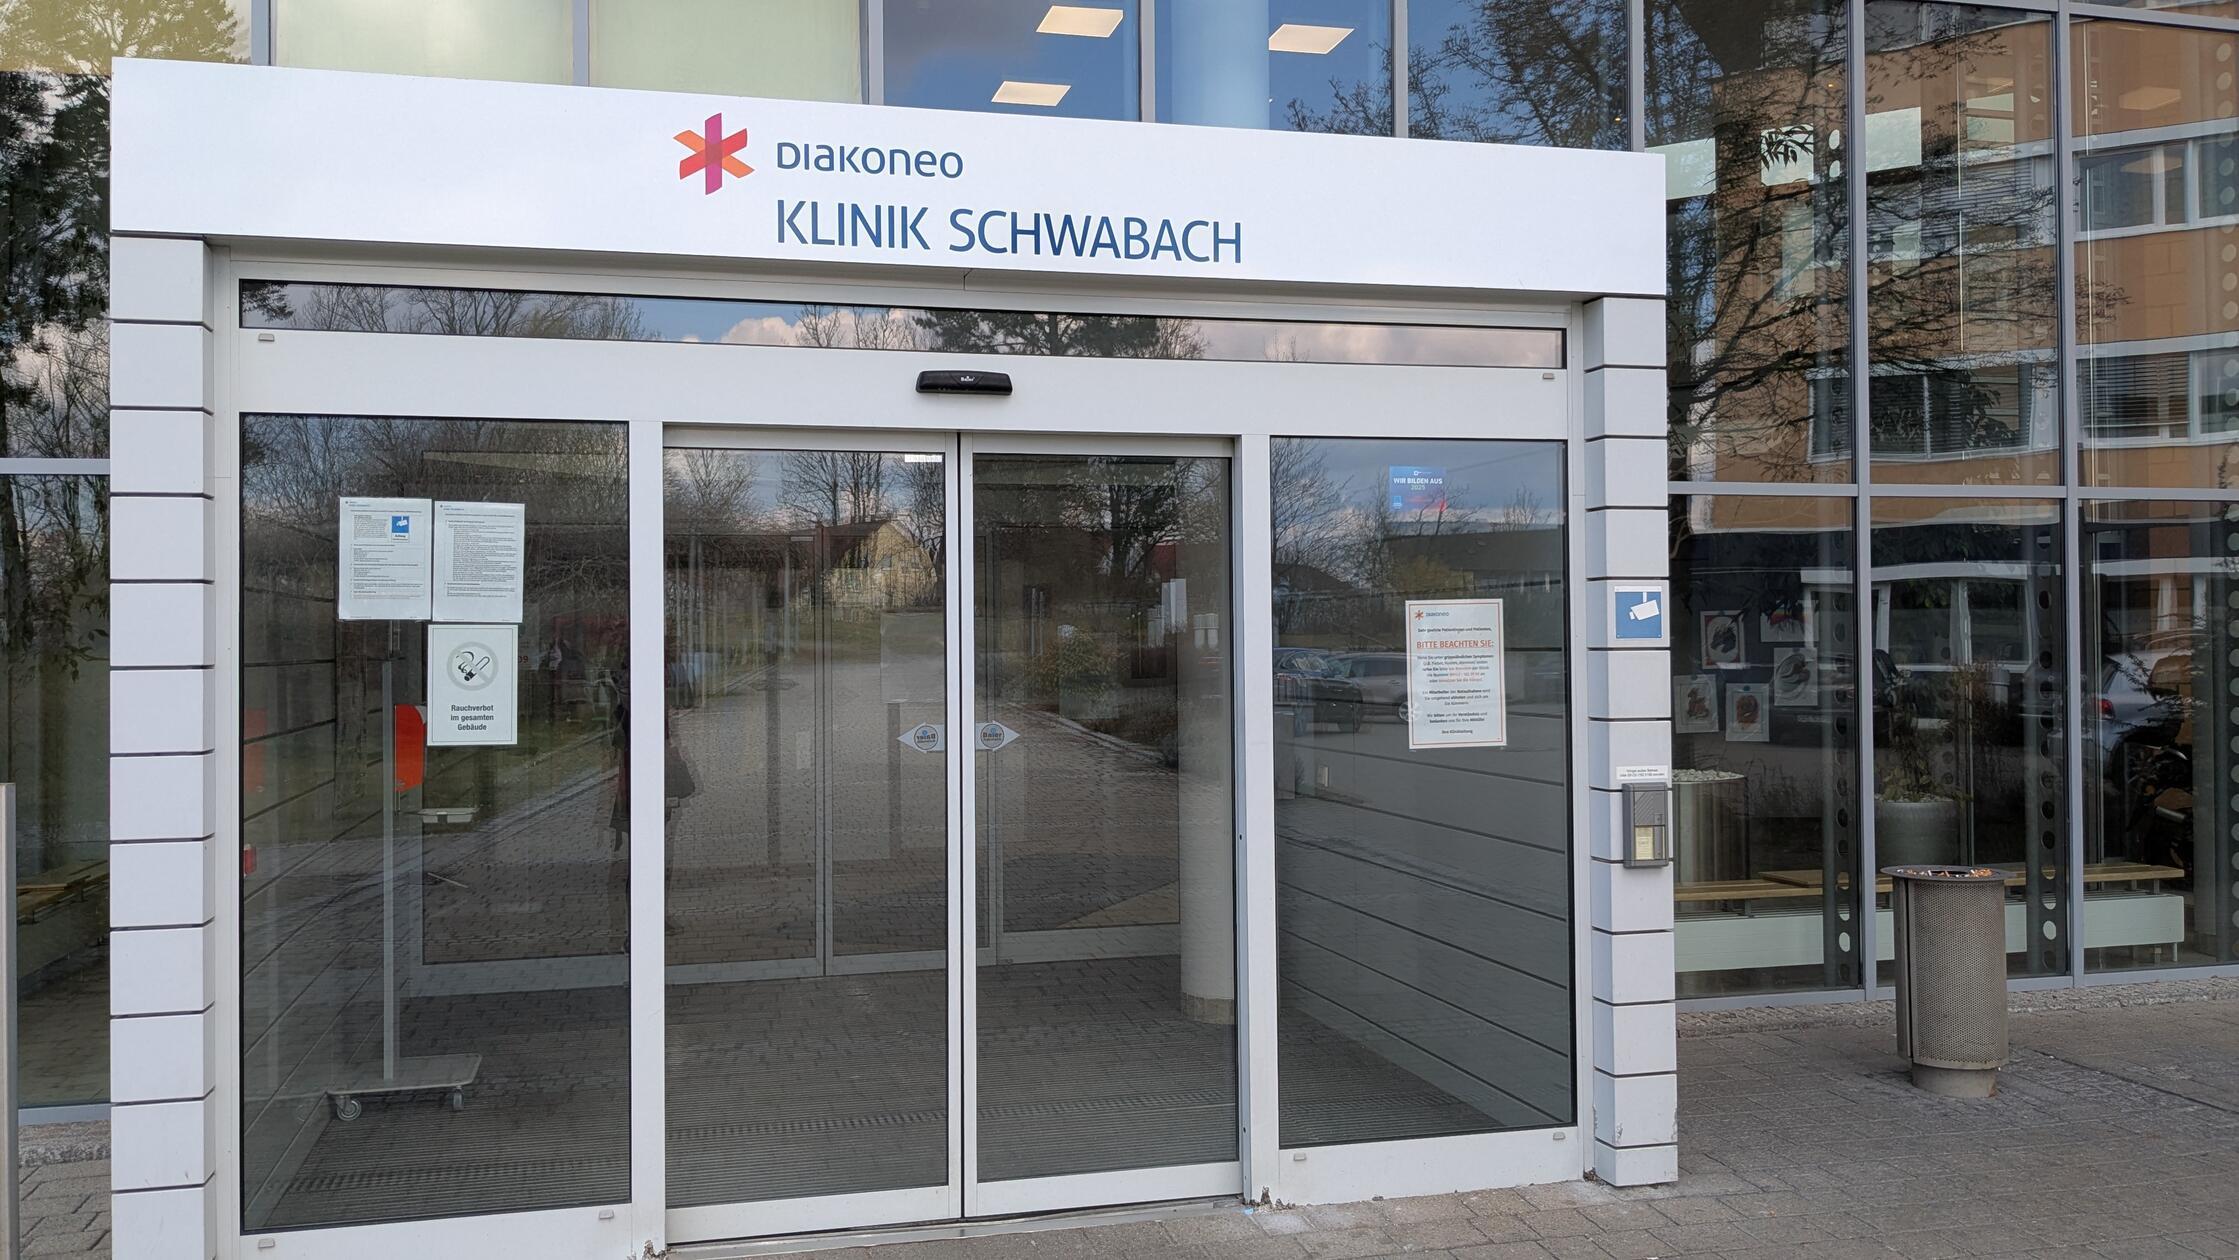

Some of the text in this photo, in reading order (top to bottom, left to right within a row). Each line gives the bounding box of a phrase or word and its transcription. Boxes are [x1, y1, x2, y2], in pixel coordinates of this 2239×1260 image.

[777, 199, 1242, 264] KLINIK SCHWABACH
[1407, 477, 1429, 485] BILDEN
[1416, 640, 1438, 649] BITTE
[1439, 640, 1478, 649] BEACHTEN
[451, 704, 494, 712] Rauchverbot
[461, 714, 494, 722] gesamten
[457, 723, 487, 731] Gebäude
